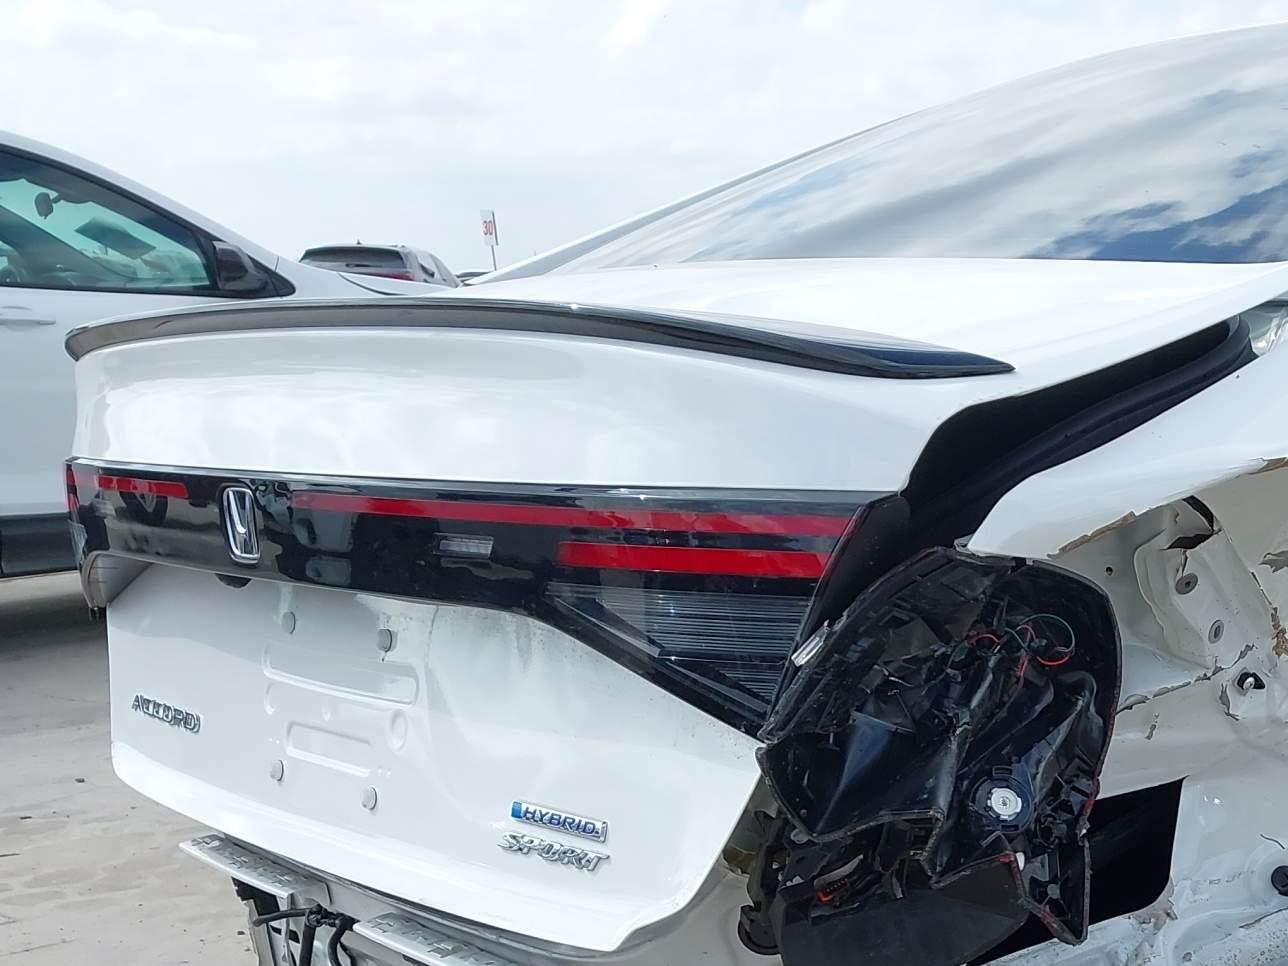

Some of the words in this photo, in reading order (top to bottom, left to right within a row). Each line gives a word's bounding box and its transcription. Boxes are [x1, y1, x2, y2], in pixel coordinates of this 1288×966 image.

[132, 694, 201, 734] ACCORD
[523, 806, 597, 836] HYBRID
[497, 833, 610, 872] SPORT
